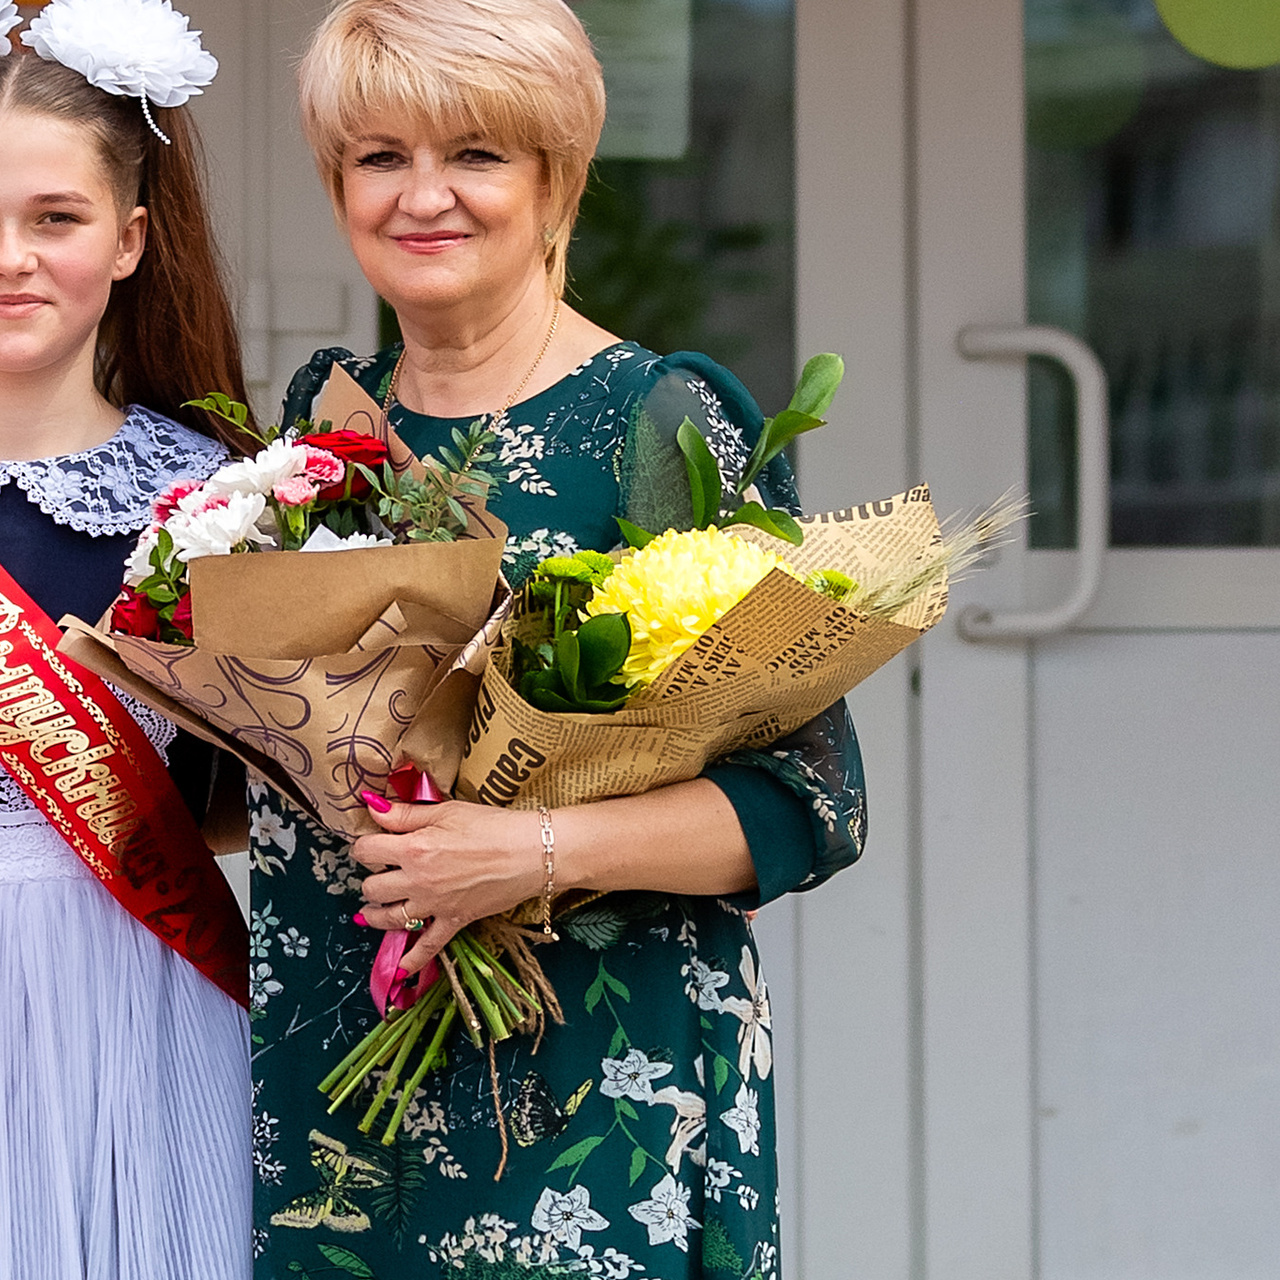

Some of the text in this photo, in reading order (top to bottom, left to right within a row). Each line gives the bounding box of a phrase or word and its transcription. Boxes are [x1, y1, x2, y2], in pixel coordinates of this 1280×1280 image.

[695, 633, 715, 659] OF
[764, 606, 847, 674] OF MAGIC
[788, 641, 821, 672] AND
